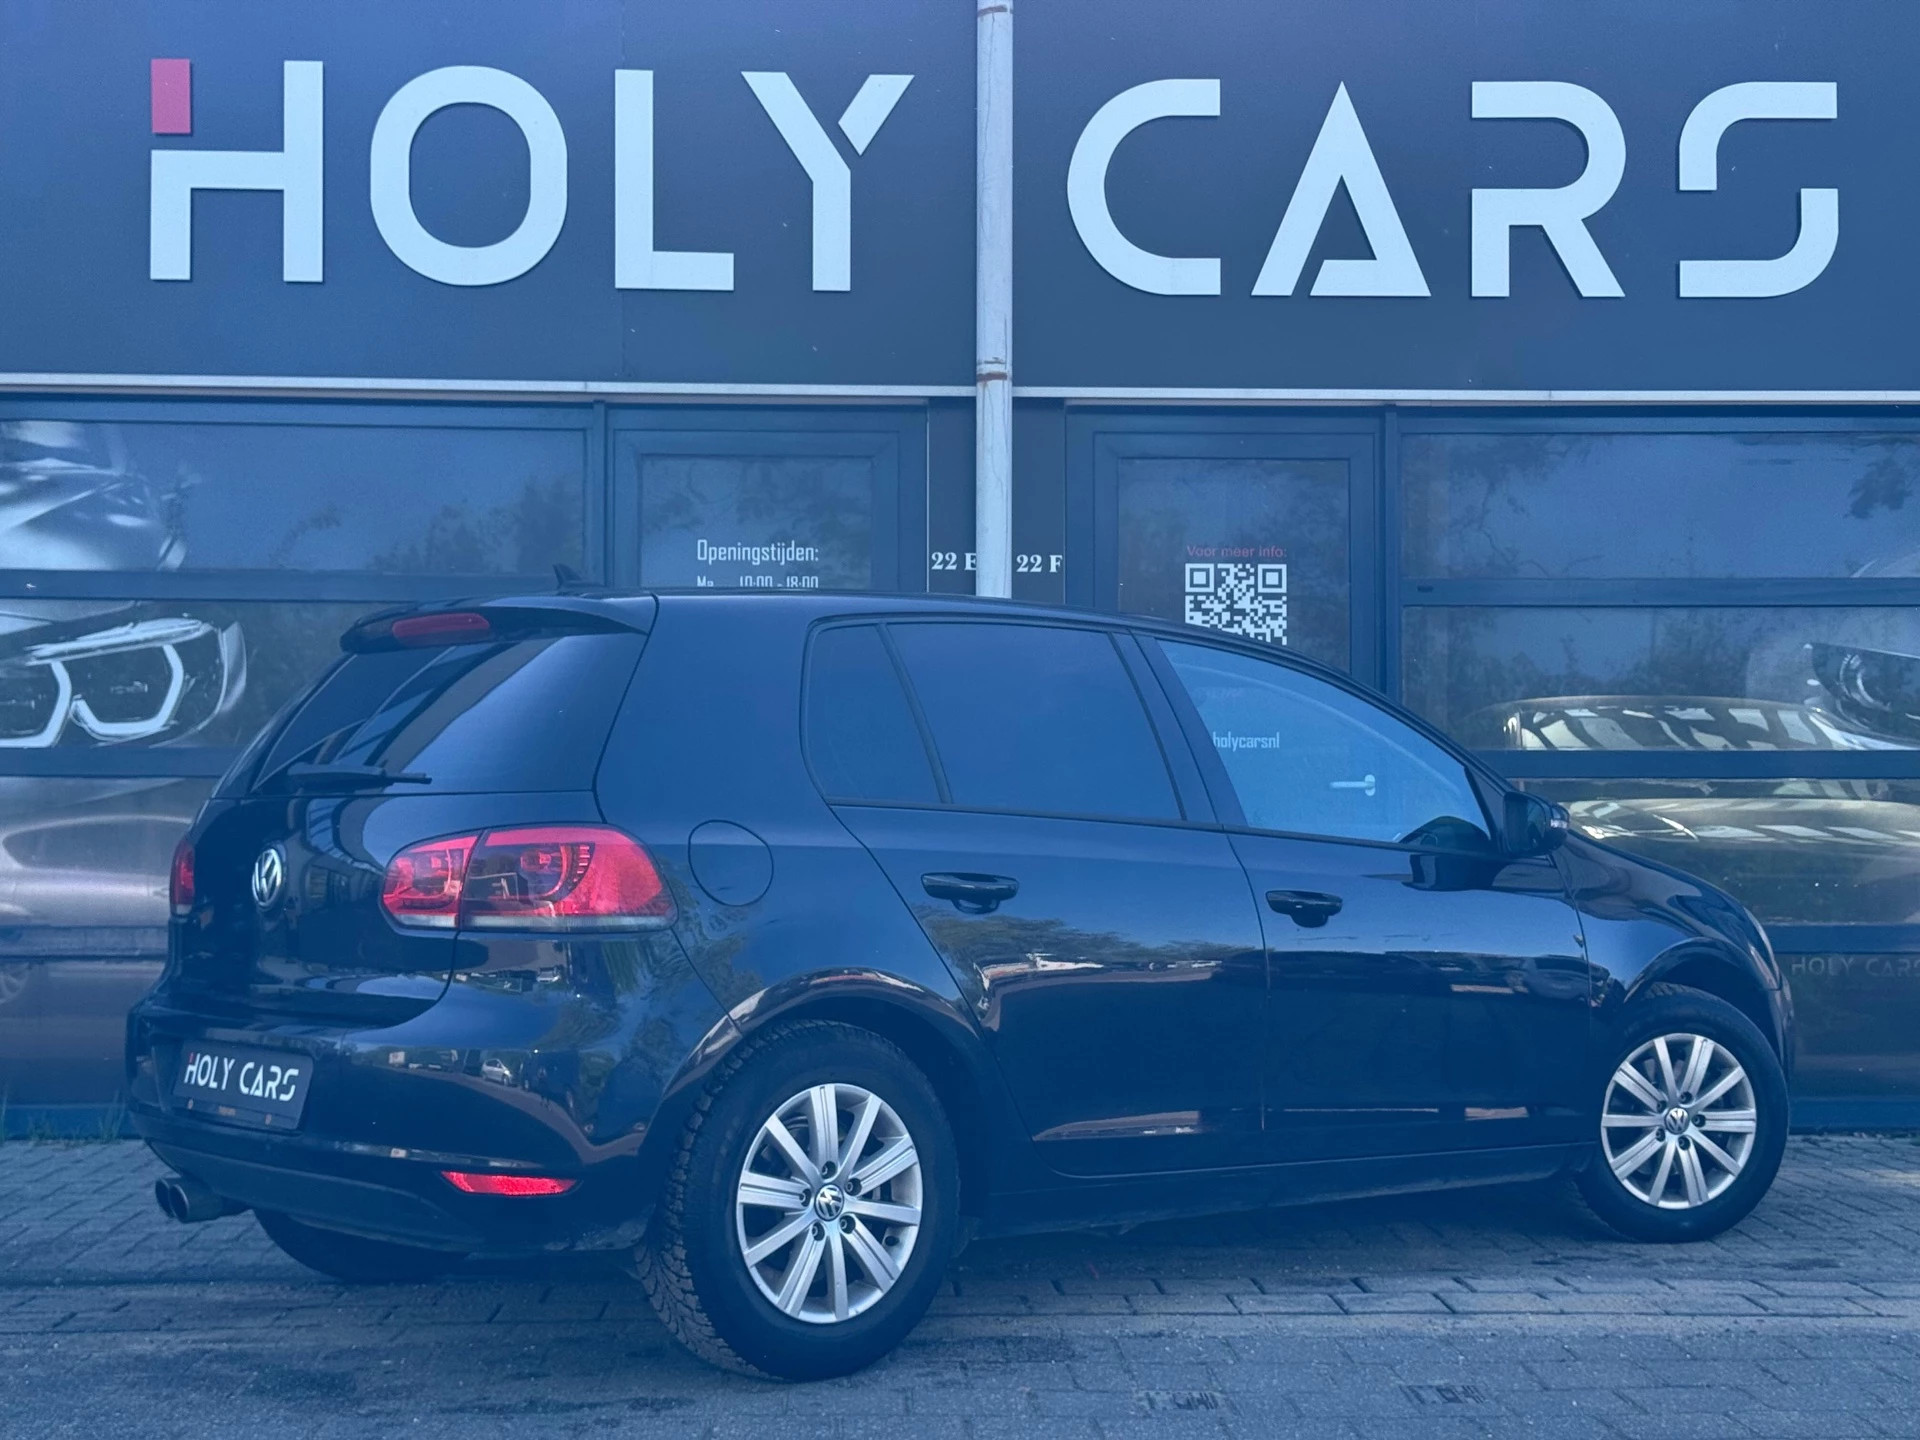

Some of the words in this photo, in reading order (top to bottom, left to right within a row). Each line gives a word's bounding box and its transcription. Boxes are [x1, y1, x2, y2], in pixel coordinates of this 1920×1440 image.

[150, 58, 915, 291] HOLY
[1067, 79, 1839, 298] CARS
[697, 538, 819, 565] Openingstijden:
[931, 552, 957, 570] 22
[964, 552, 977, 571] E
[1186, 545, 1217, 557] Voor
[1221, 547, 1256, 557] meer
[1259, 545, 1288, 557] info:
[1016, 554, 1042, 572] 22
[1049, 554, 1063, 573] F
[1212, 731, 1280, 752] holycarsnl
[1791, 956, 1854, 977] HOLY
[183, 1052, 236, 1091] HOLY
[239, 1061, 300, 1102] CARS
